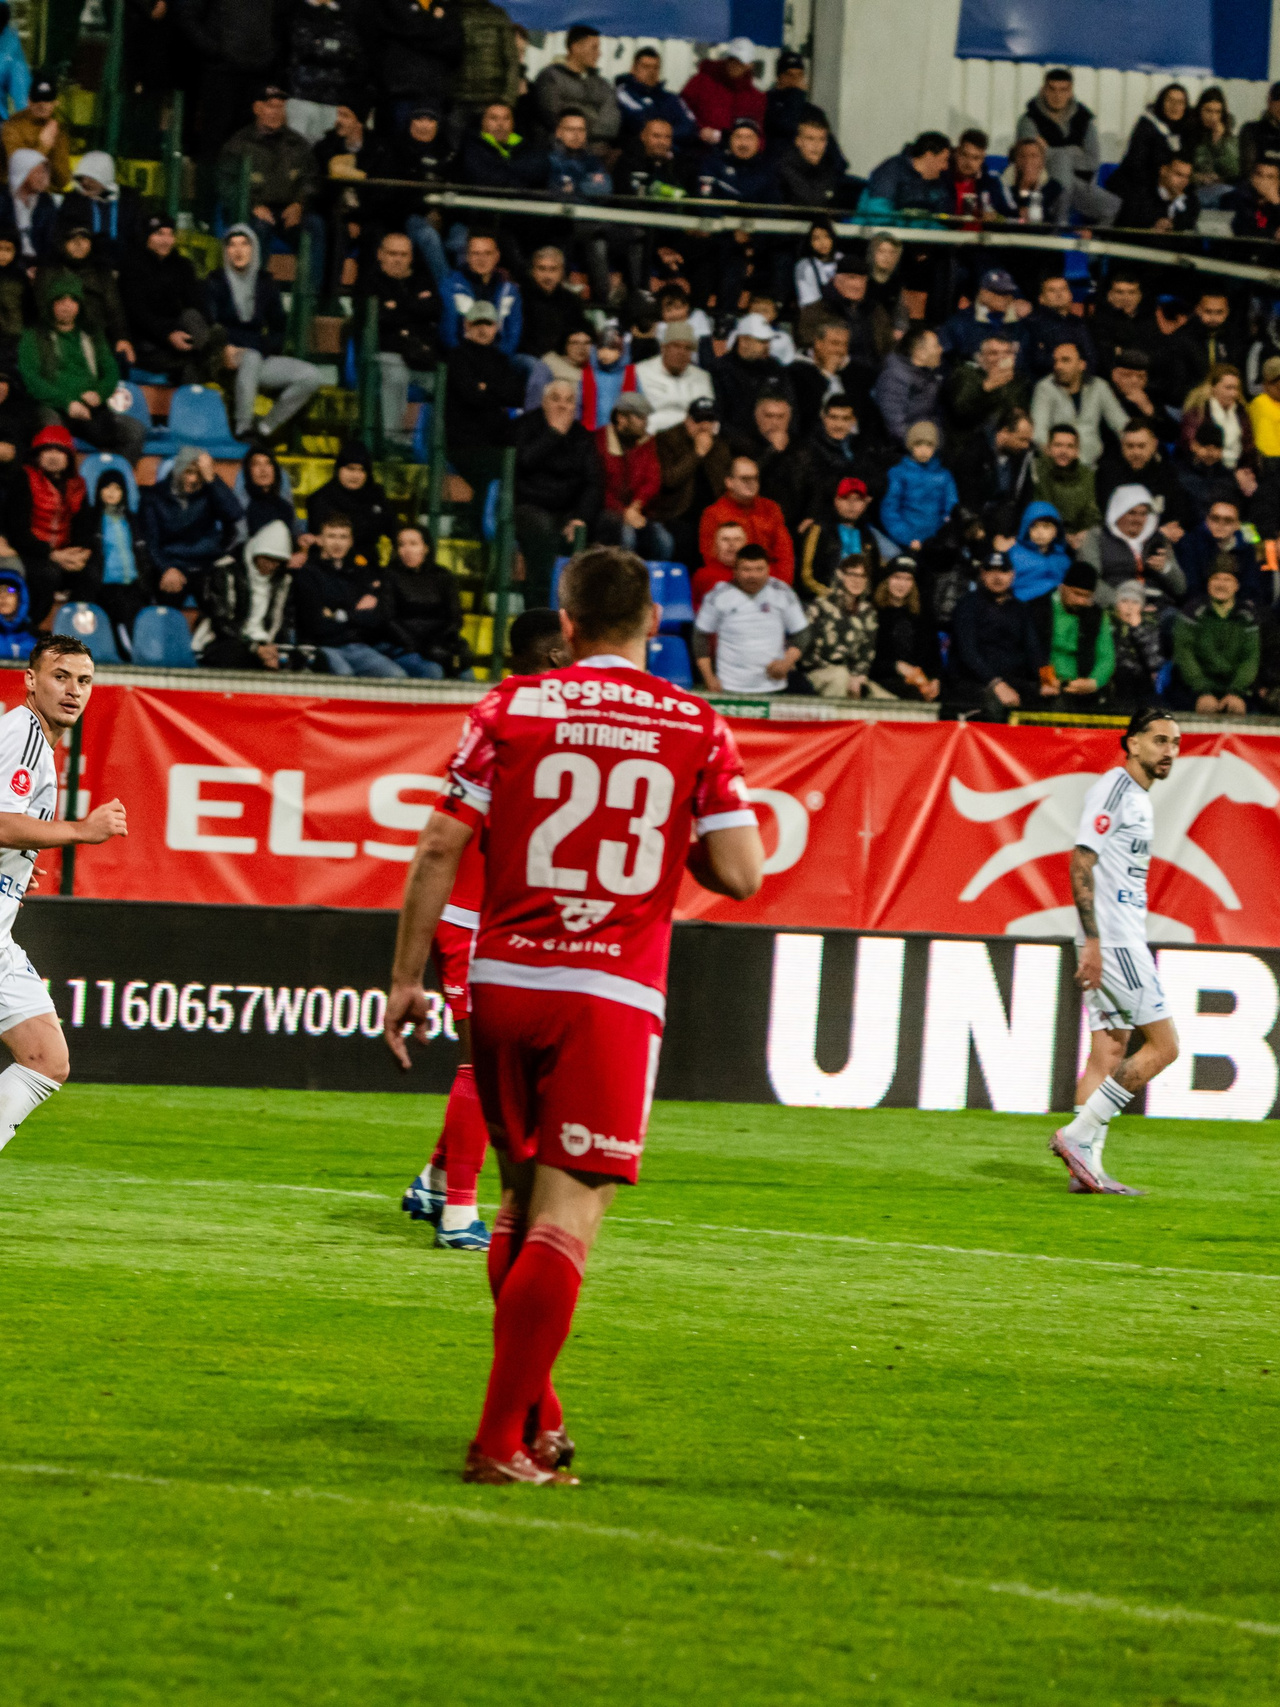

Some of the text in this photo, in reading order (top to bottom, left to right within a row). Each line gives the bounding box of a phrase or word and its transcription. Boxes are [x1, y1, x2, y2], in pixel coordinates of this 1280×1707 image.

[540, 678, 701, 717] Regata.ro
[555, 721, 662, 753] PATRICHE
[526, 751, 675, 896] 23
[42, 977, 459, 1041] 1160657W0003
[765, 932, 1280, 1121] UNB
